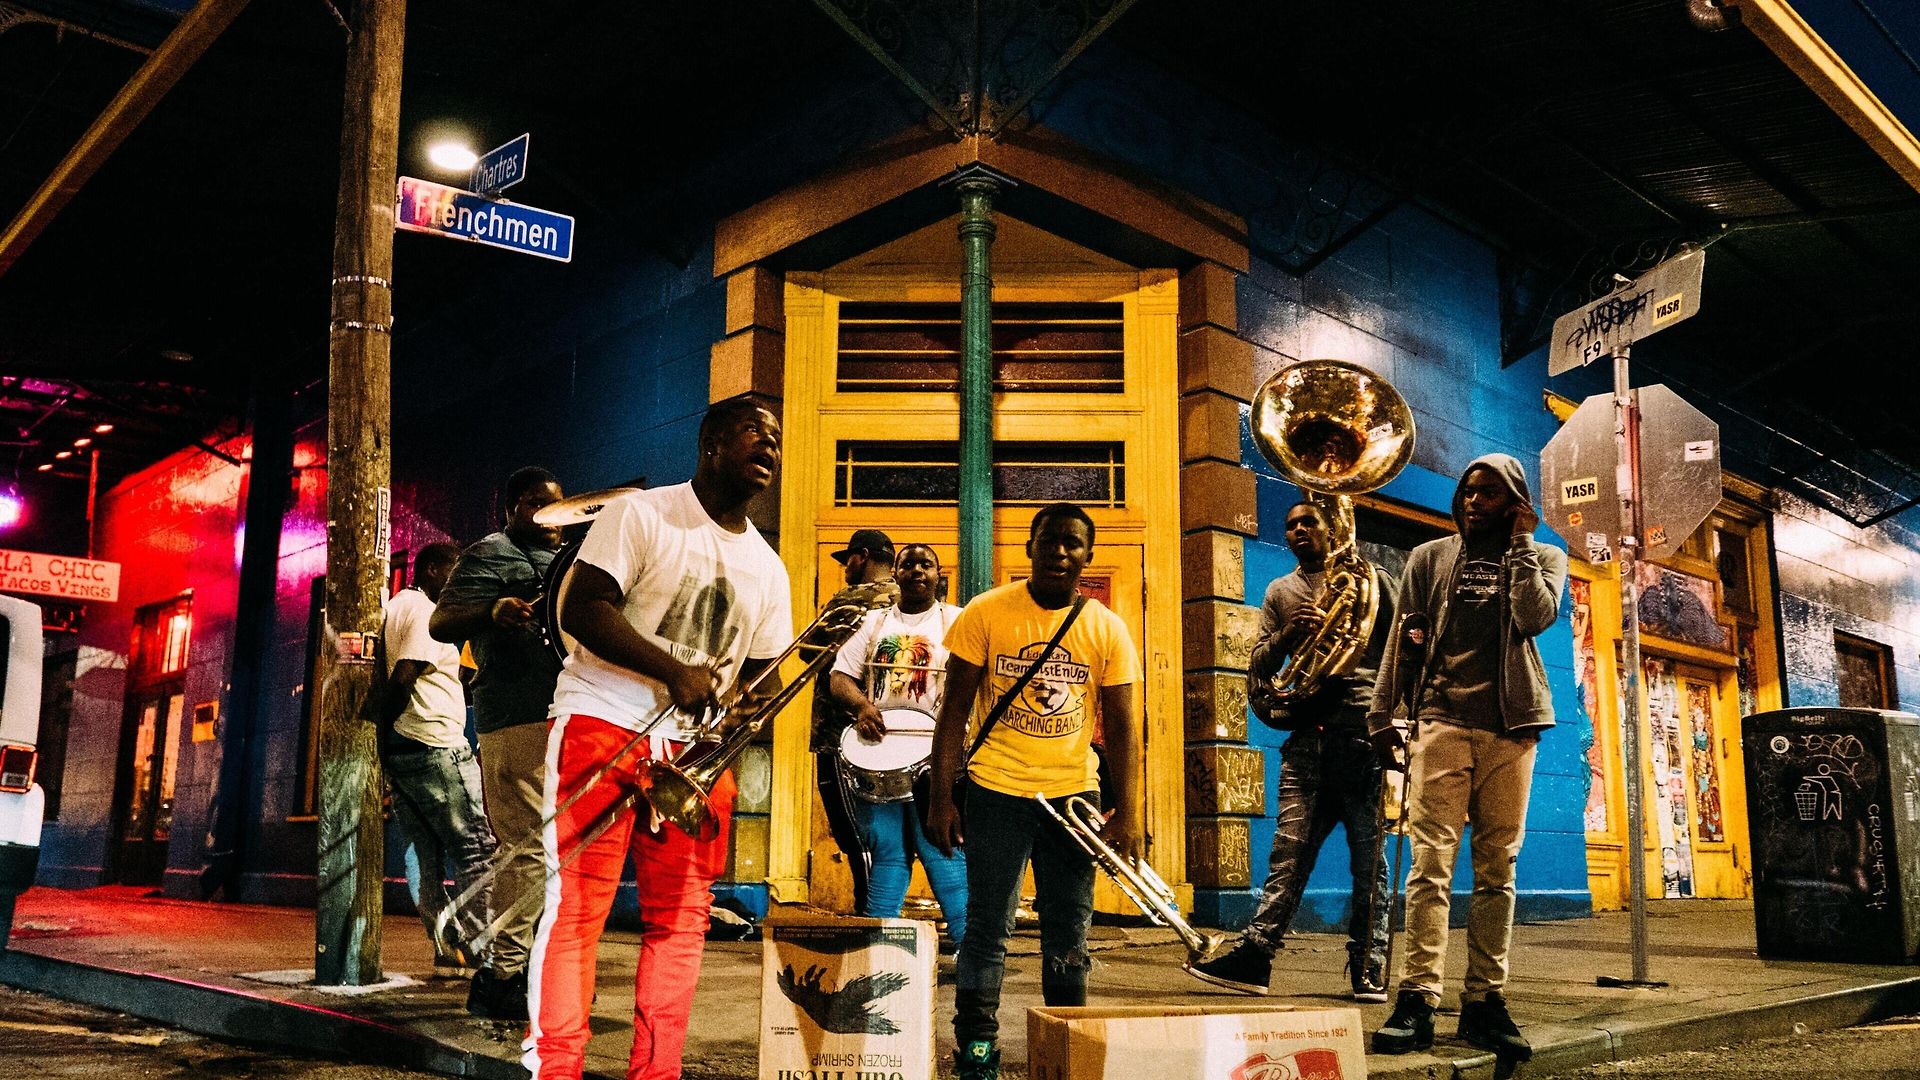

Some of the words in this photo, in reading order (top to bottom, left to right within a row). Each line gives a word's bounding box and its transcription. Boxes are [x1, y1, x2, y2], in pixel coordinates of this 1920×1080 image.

[475, 153, 518, 193] Chartres
[414, 188, 558, 251] Frenchmen
[1655, 299, 1680, 319] YASR
[1565, 482, 1596, 499] YASR
[0, 551, 33, 573] LA
[48, 559, 106, 581] CHIC
[0, 573, 51, 592] TACOS
[57, 580, 111, 598] WINGS
[1243, 1031, 1269, 1043] Family
[1271, 1030, 1306, 1040] Tradition
[1307, 1029, 1329, 1039] Since
[1331, 1027, 1348, 1037] 1921
[811, 1053, 855, 1067] SHRIMP
[858, 1054, 903, 1068] FROZEN
